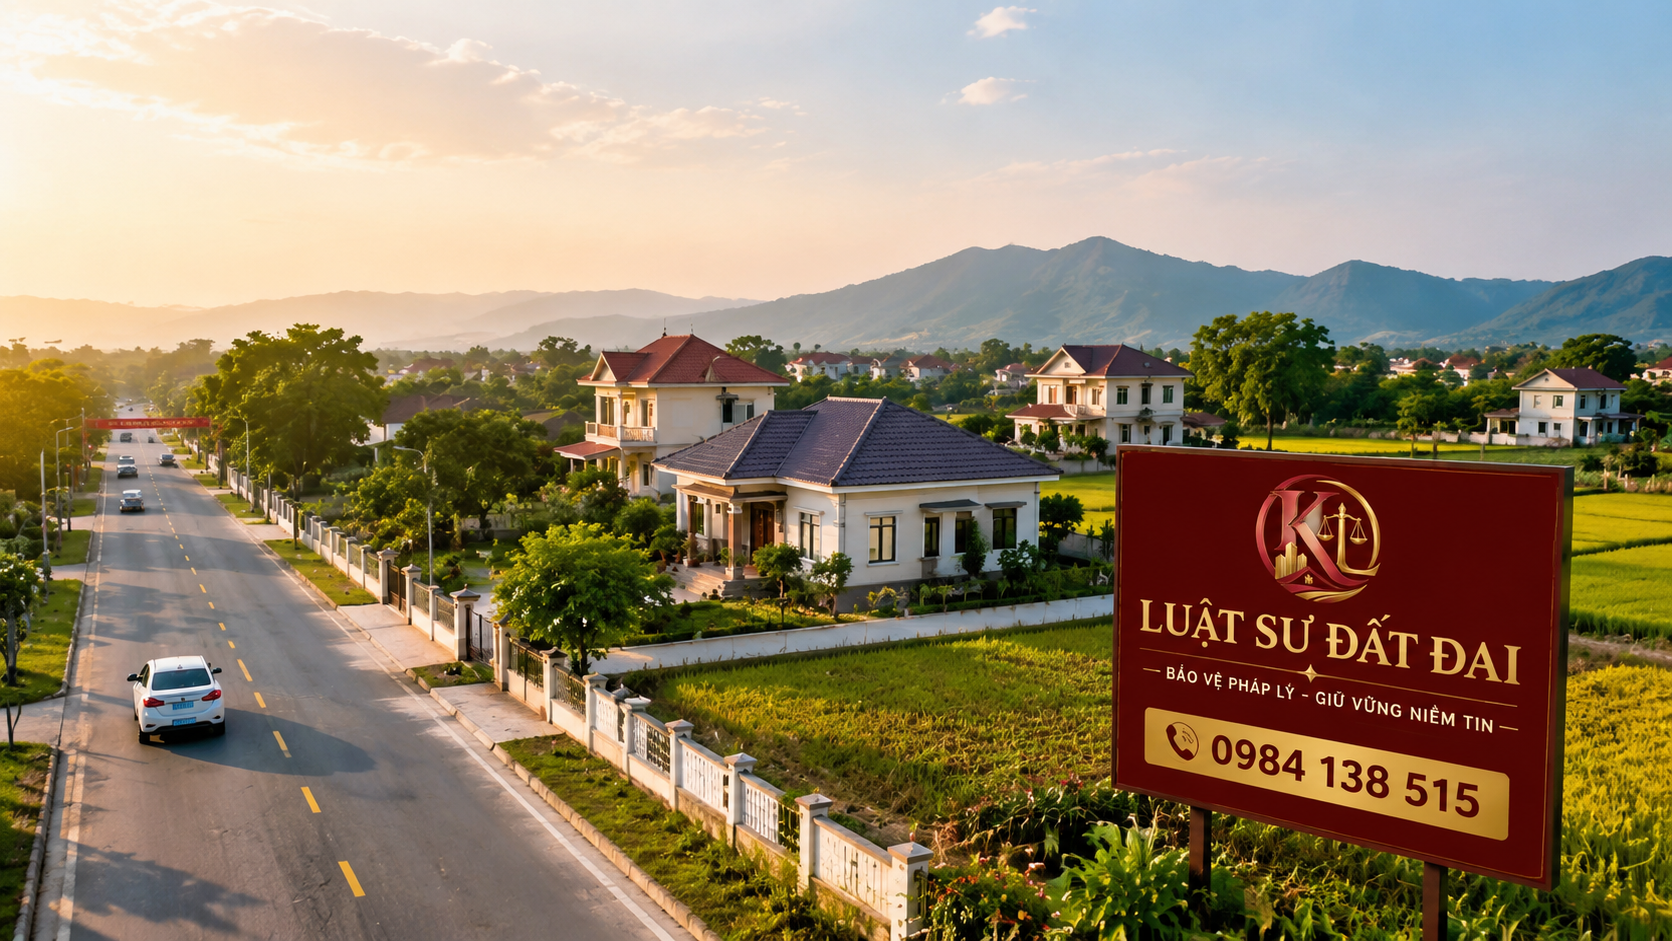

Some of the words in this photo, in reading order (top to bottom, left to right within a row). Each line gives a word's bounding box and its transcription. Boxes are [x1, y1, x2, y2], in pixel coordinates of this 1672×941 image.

[1139, 597, 1244, 648] LUẬT
[1255, 614, 1315, 654] SƯ
[1325, 614, 1419, 669] ĐẤT
[1429, 636, 1522, 685] ĐAI
[1203, 671, 1223, 691] VỆ
[1228, 676, 1271, 696] PHÁP
[1276, 682, 1295, 700] LÝ
[1351, 695, 1402, 718] VỮNG
[1410, 704, 1456, 727] NIỀM
[1462, 714, 1494, 734] TIN
[1211, 734, 1306, 782] 0984
[1320, 756, 1390, 799] 138
[1404, 771, 1480, 819] 515
